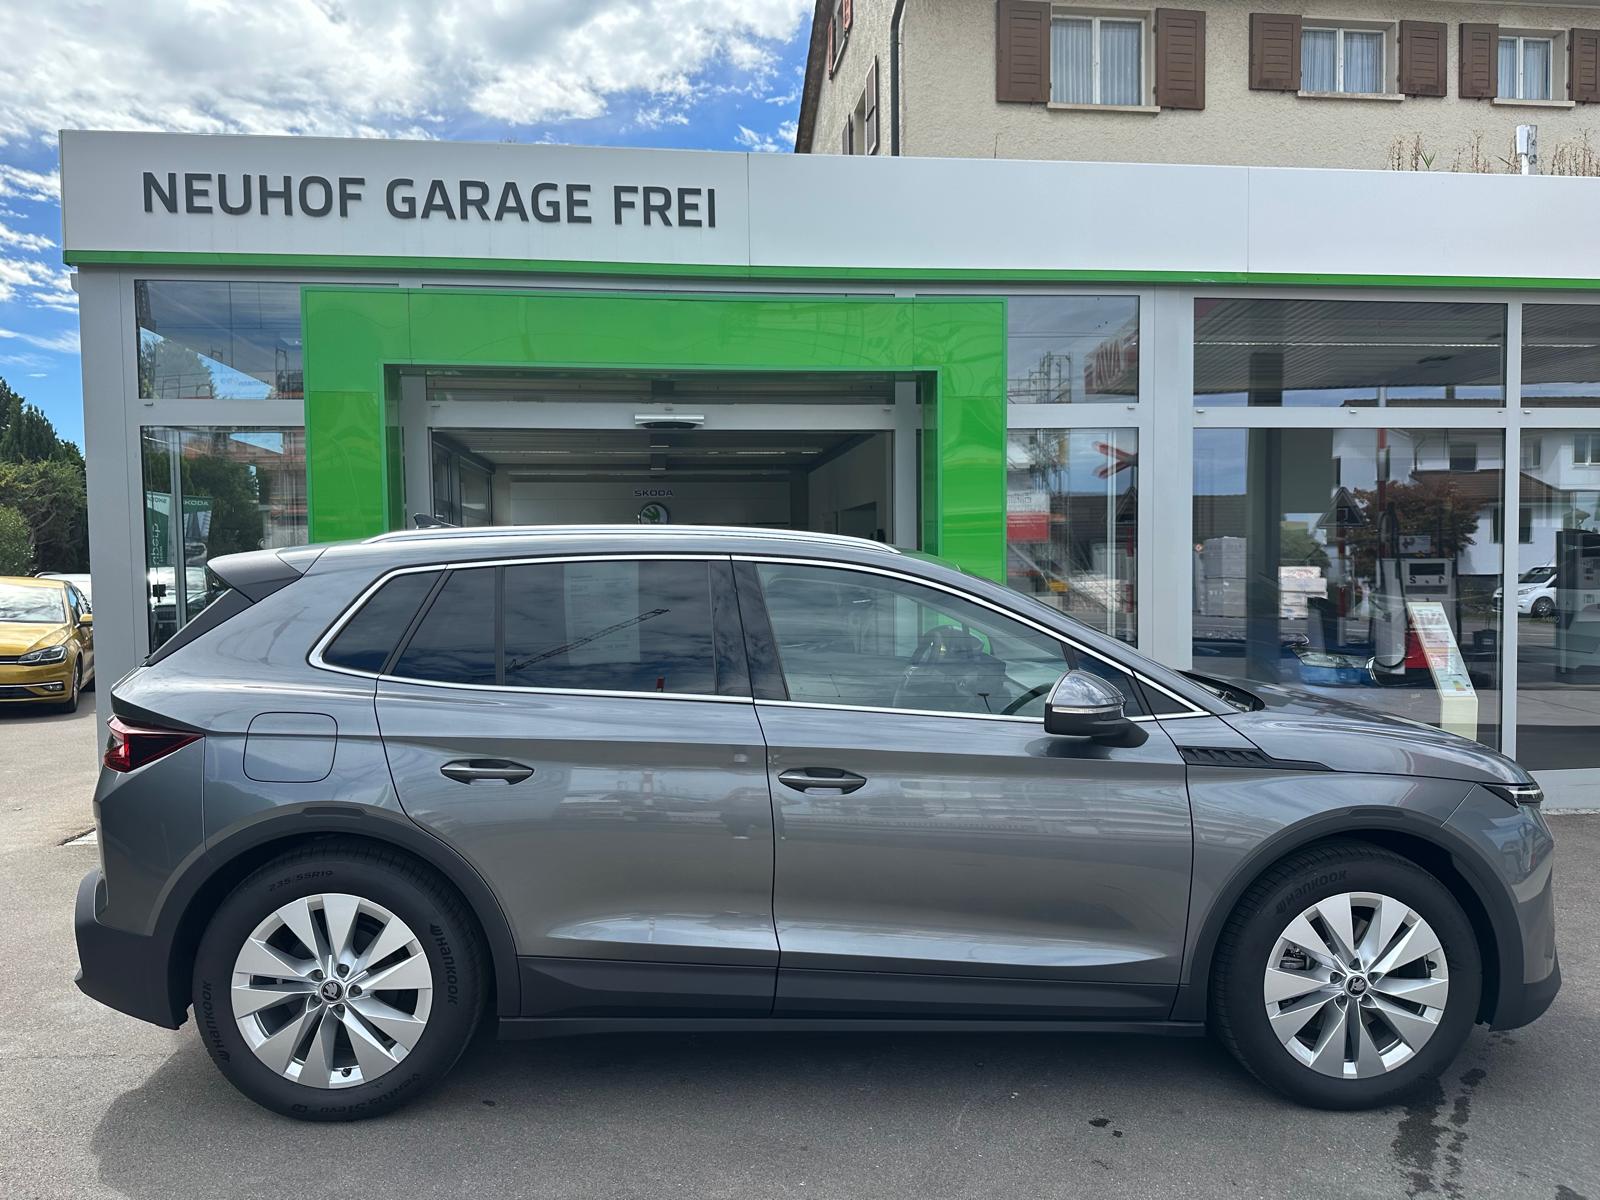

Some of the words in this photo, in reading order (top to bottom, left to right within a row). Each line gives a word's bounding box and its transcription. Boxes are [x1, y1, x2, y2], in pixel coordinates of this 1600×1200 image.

[143, 171, 366, 217] NEUHOF
[386, 178, 593, 224] GARAGE
[613, 185, 716, 228] FREI
[634, 489, 674, 497] SKODA
